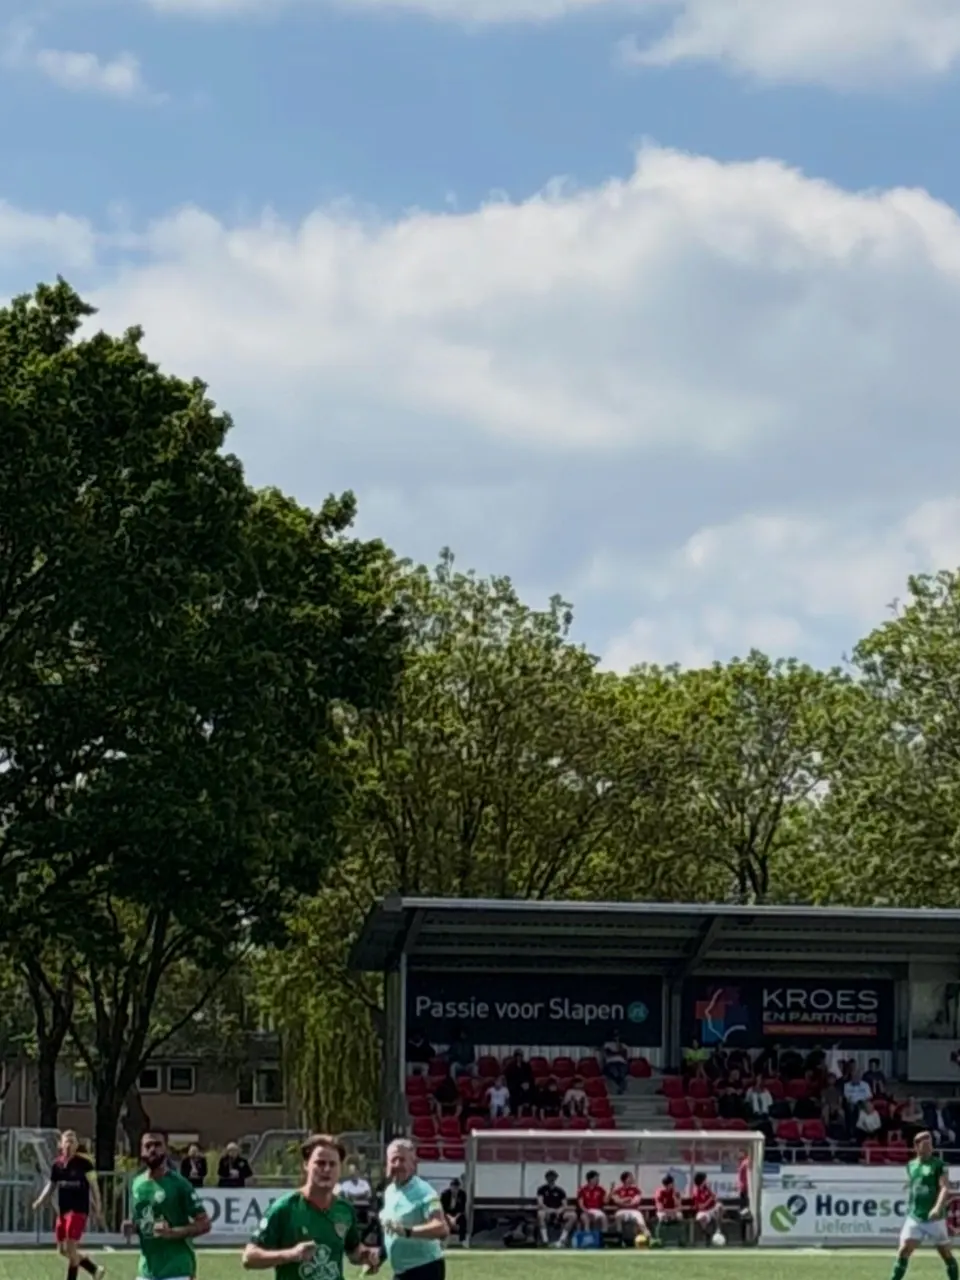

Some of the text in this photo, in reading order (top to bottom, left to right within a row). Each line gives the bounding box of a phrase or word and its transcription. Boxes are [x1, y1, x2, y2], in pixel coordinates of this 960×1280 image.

[762, 988, 878, 1010] KROES
[415, 996, 490, 1019] Passie
[494, 1002, 544, 1019] voor
[549, 997, 624, 1026] Slapen
[763, 1011, 878, 1024] EN PARTNERS
[815, 1194, 906, 1217] Horesc
